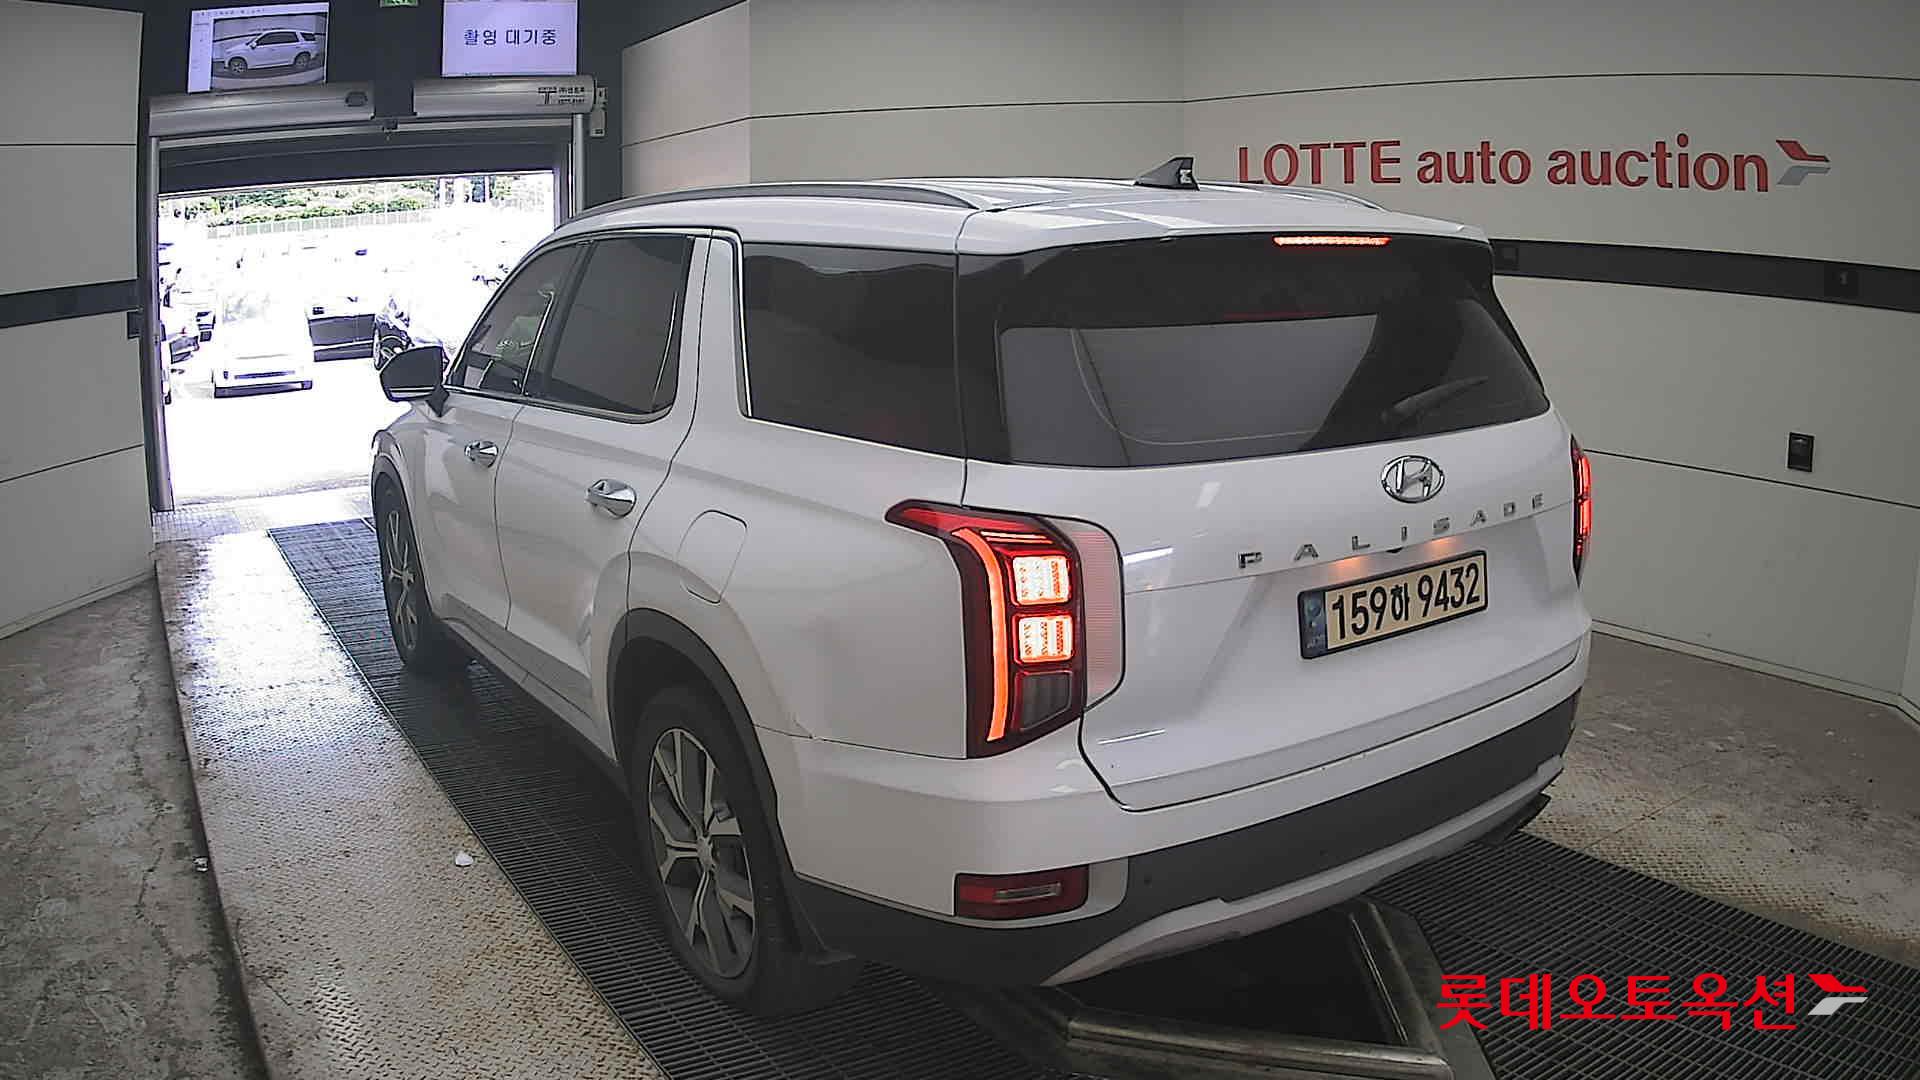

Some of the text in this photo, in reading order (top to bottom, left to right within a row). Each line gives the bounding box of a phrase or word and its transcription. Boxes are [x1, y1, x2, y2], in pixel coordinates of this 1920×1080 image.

[463, 28, 557, 46] 촬영 대기중
[1239, 133, 1769, 193] LOTTE auto auction
[1237, 493, 1545, 569] PALISADE
[1331, 562, 1481, 640] 159하 9432
